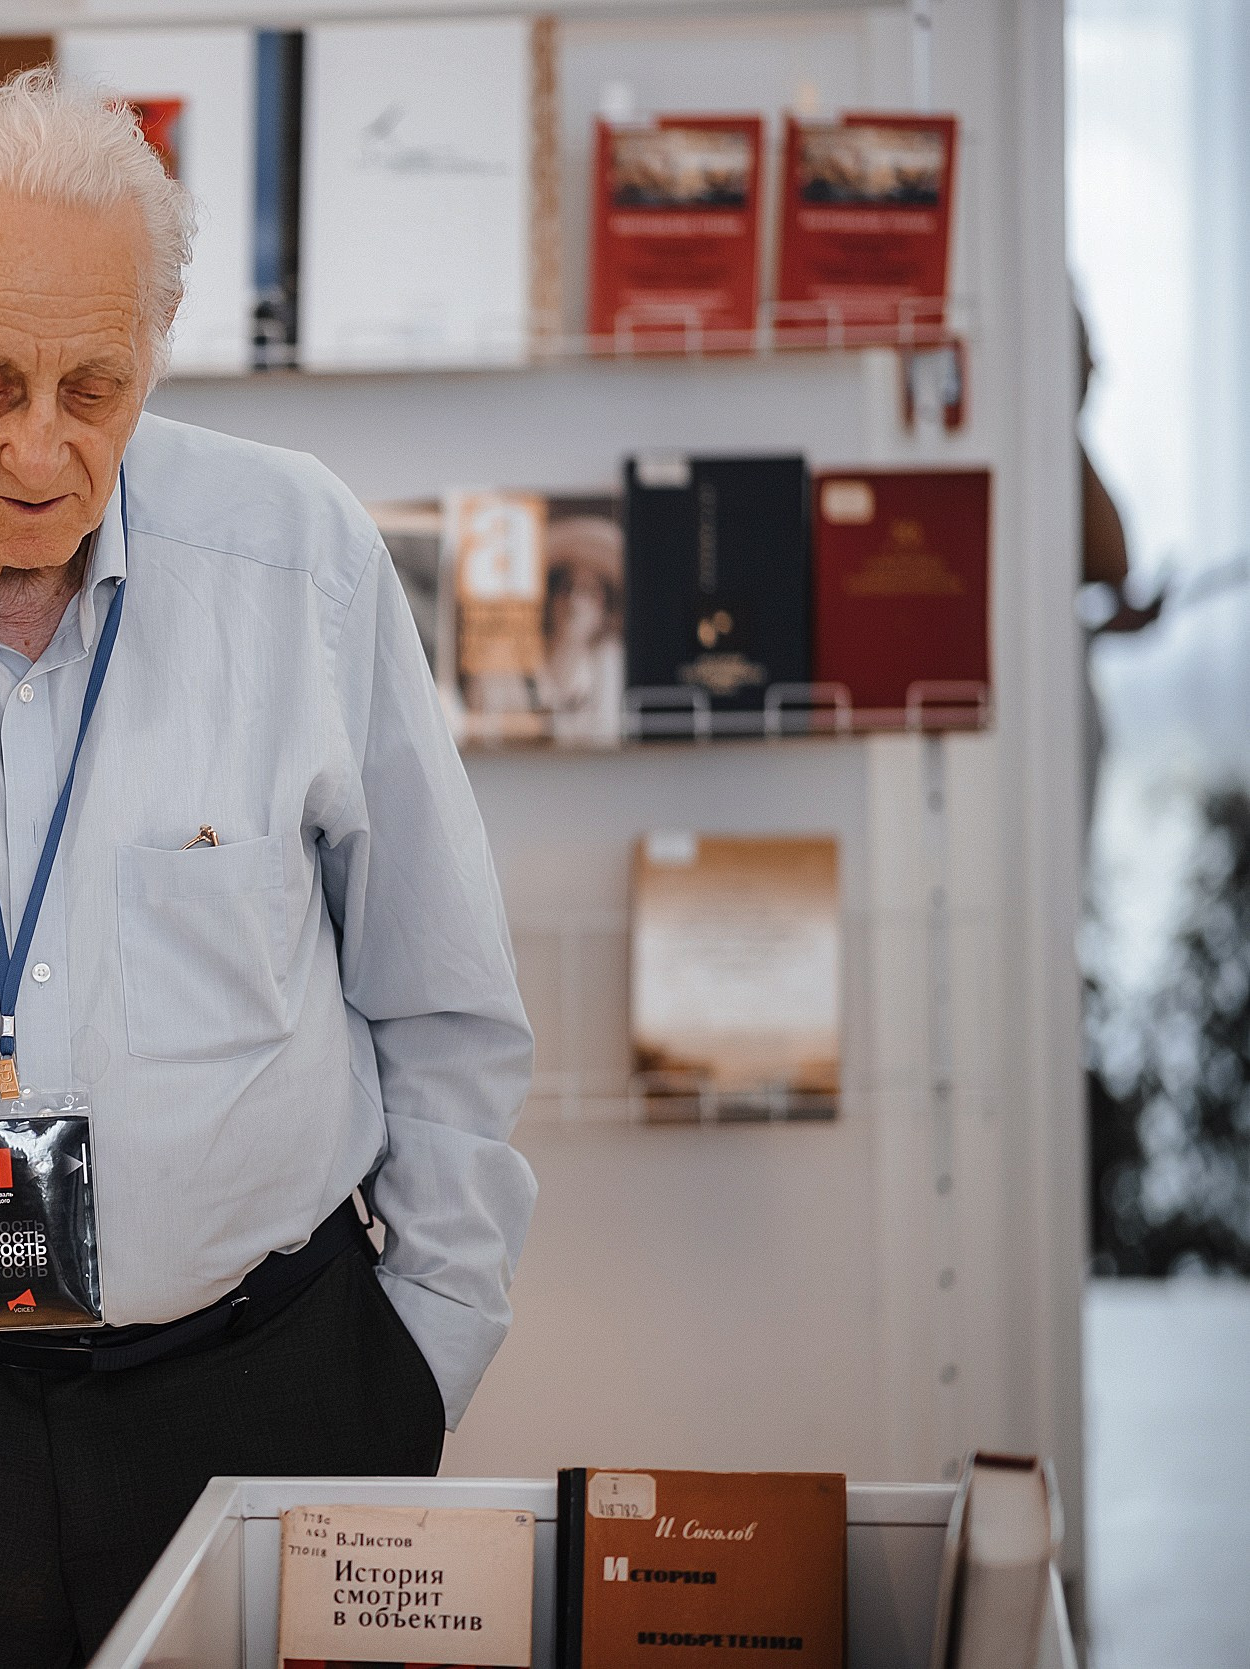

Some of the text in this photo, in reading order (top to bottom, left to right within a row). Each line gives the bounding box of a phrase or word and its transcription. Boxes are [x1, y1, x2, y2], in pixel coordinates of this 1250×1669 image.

[654, 1516, 759, 1541] И. Соколов
[335, 1560, 445, 1588] История
[333, 1588, 444, 1611] смотрит
[333, 1607, 483, 1631] в объектив
